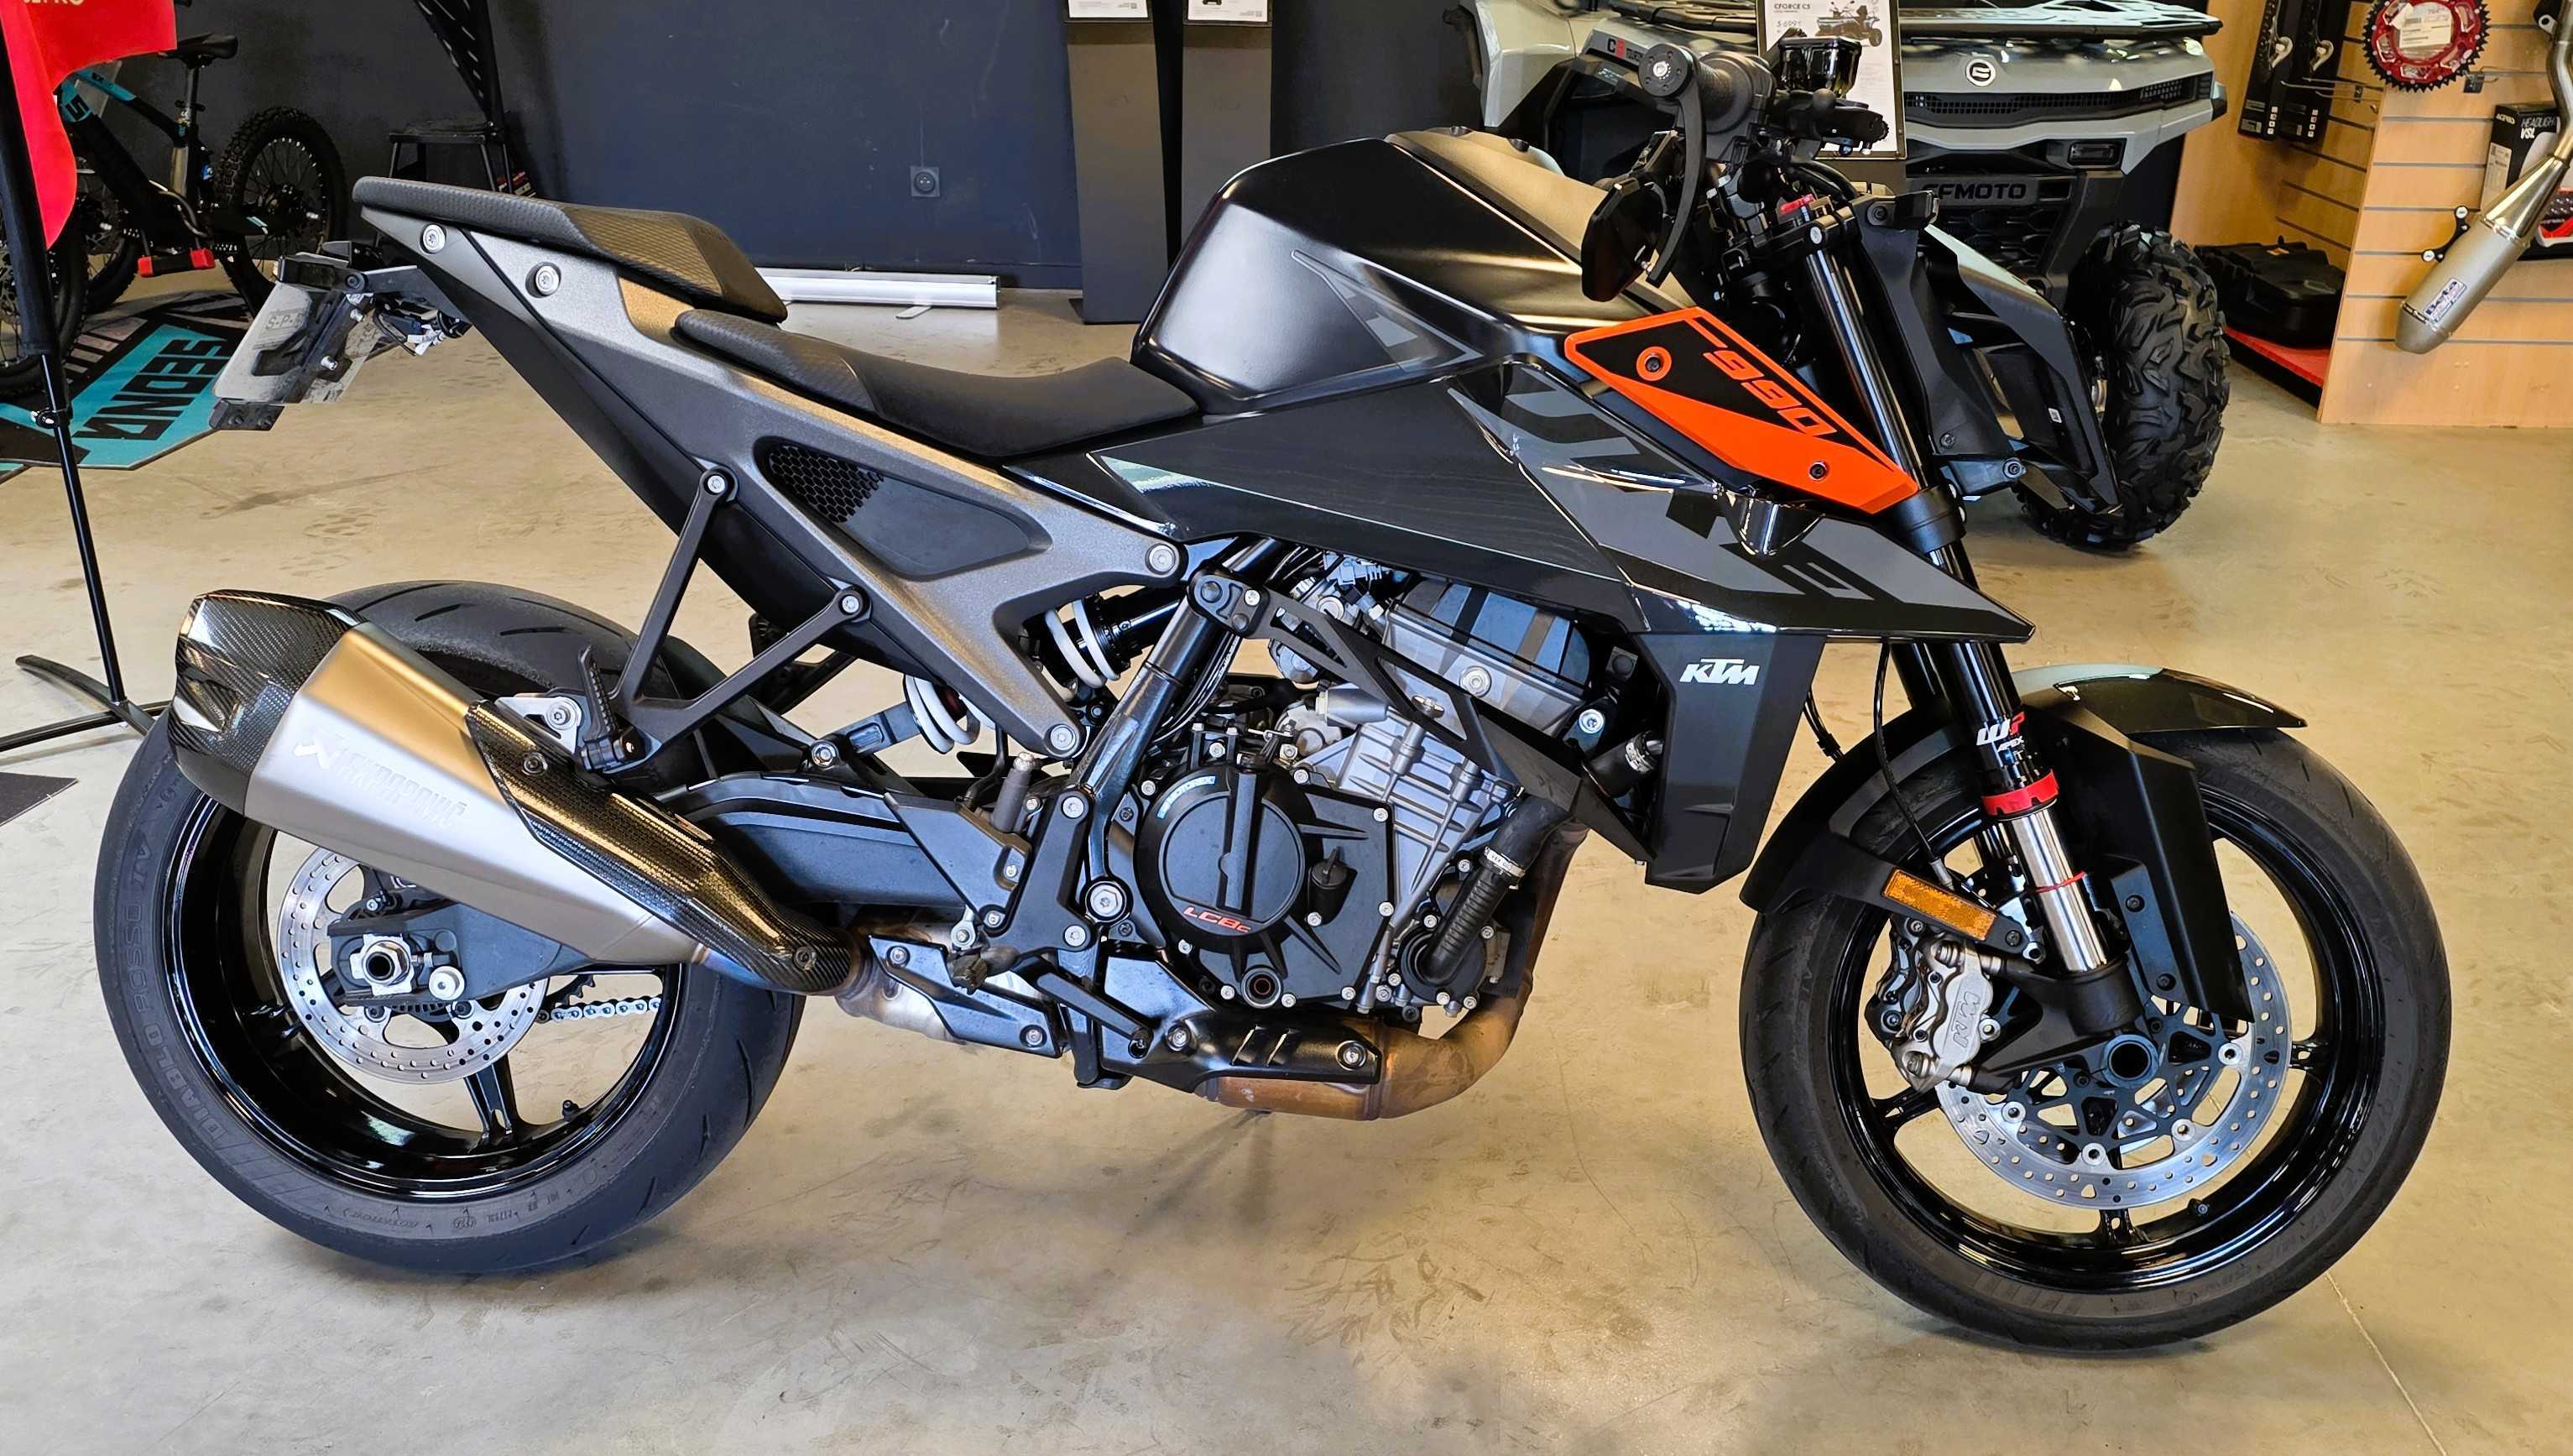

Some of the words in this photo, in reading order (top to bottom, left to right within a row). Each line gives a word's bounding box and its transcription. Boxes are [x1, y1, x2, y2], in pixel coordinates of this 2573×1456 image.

[1703, 350, 1838, 436] 990
[1679, 658, 1760, 686] KTM
[1976, 712, 2025, 745] WP
[1952, 991, 1981, 1048] KTM
